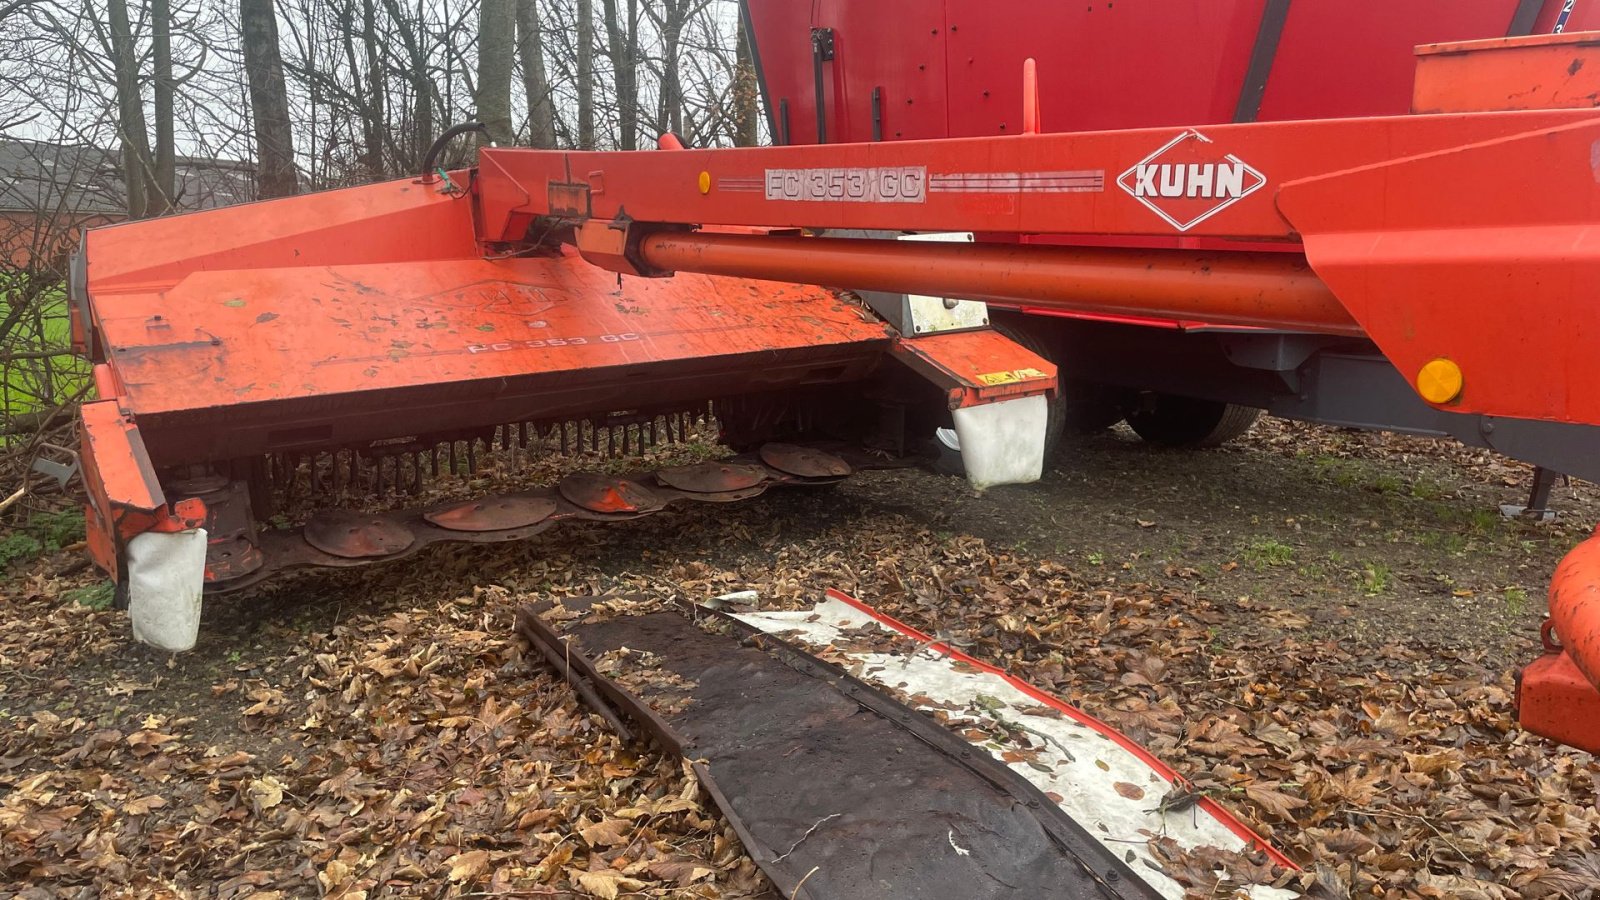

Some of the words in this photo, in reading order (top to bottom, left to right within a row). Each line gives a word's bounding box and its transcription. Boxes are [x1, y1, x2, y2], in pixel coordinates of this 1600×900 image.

[767, 171, 800, 198] FC
[810, 170, 866, 198] 353
[879, 168, 921, 198] GC
[1134, 163, 1244, 198] KUHN
[467, 343, 513, 354] FC
[526, 337, 588, 348] 353
[600, 332, 640, 343] GC
